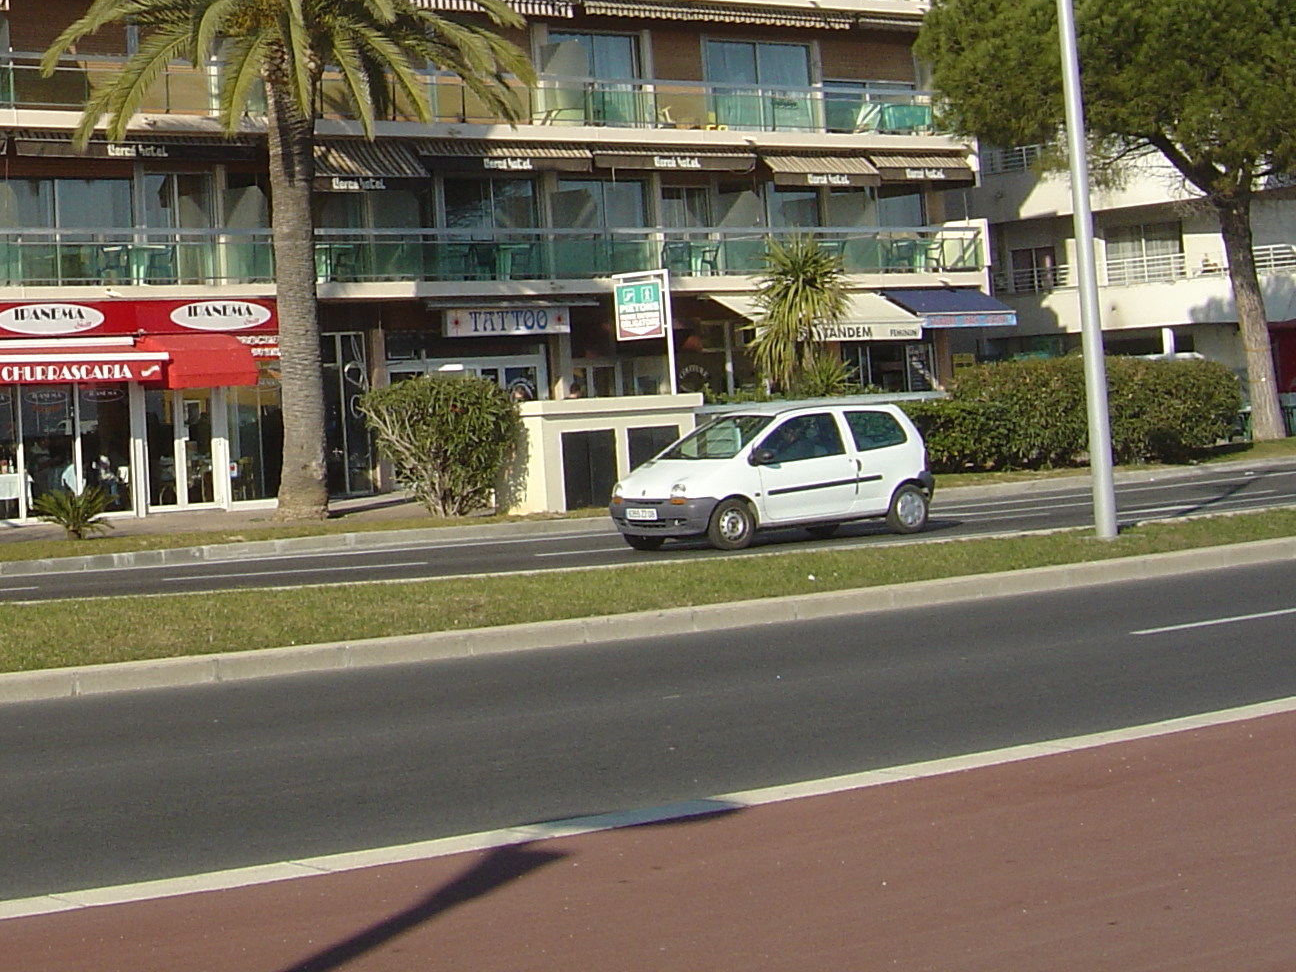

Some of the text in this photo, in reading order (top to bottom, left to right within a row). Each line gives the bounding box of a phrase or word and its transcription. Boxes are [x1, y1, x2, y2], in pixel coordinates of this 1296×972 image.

[14, 307, 85, 321] IPANEMA
[187, 304, 254, 319] IPANEMA
[469, 309, 548, 333] TATTOO
[1, 364, 133, 382] CHURRASCARIA
